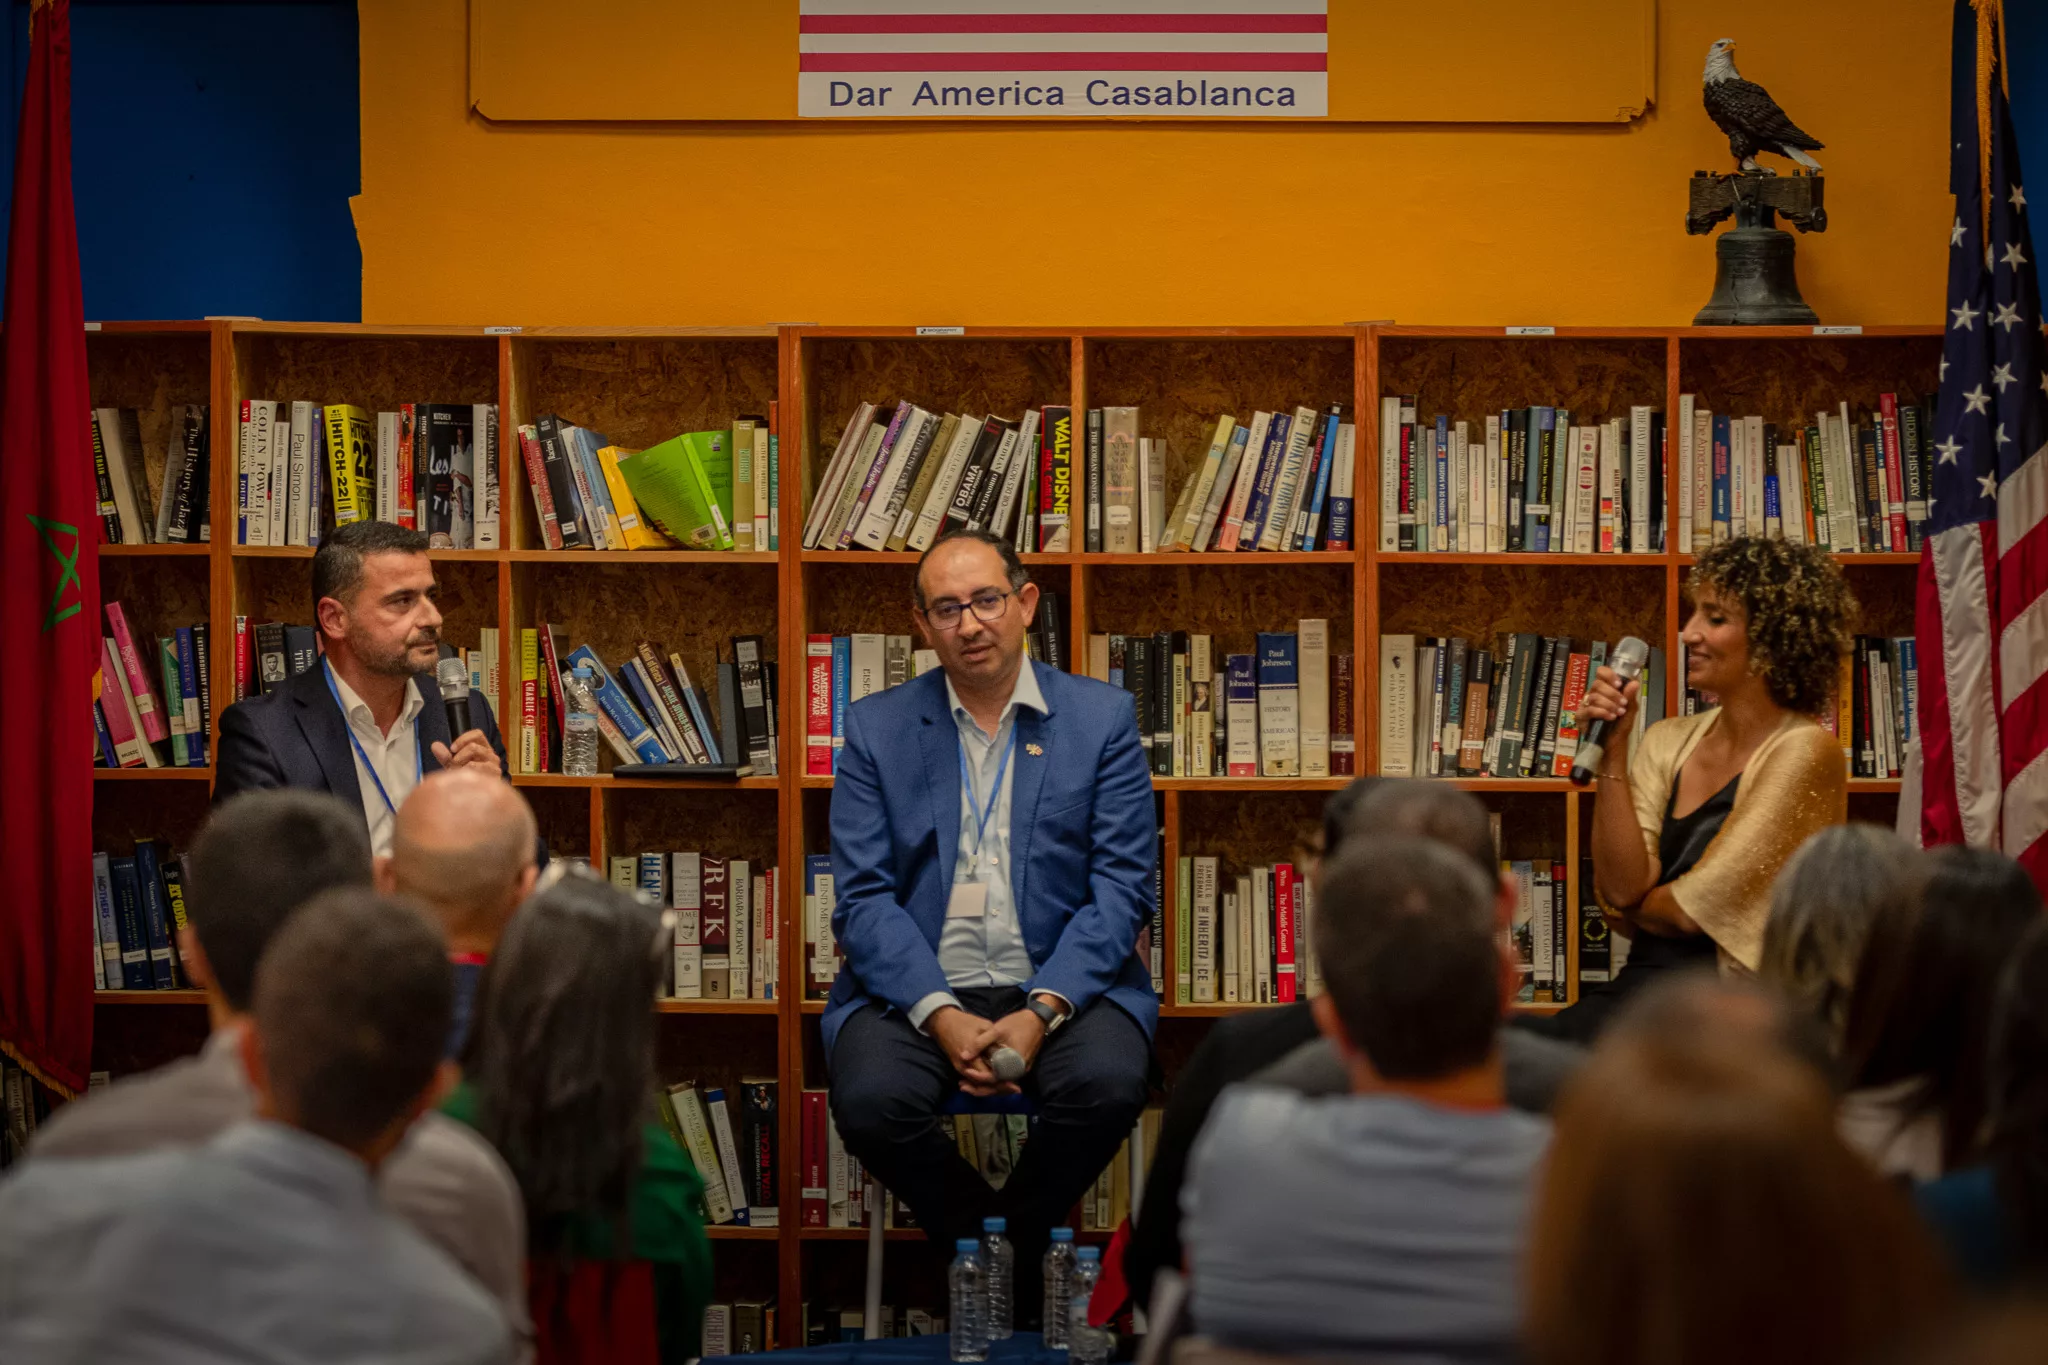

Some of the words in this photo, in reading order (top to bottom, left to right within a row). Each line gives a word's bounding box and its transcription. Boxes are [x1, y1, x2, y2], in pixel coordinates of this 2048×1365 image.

[829, 80, 892, 107] Dar
[912, 80, 1065, 107] America
[1086, 79, 1296, 107] Casablanca
[242, 406, 249, 419] MY
[433, 412, 451, 420] KITCHEN
[1636, 410, 1648, 426] THE
[188, 426, 200, 446] The
[258, 406, 268, 454] COLIN
[487, 414, 496, 465] KATHARINE
[1003, 432, 1014, 449] BOB
[1054, 416, 1070, 464] WALT
[1636, 427, 1648, 442] DAY
[1697, 420, 1708, 437] The
[1906, 411, 1917, 452] HIDDEN
[293, 433, 305, 459] Paul
[354, 440, 374, 479] 22
[904, 420, 931, 474] KATHARINE
[994, 446, 1008, 471] DYLAN
[1090, 445, 1098, 473] KOREAN
[1263, 439, 1278, 471] American
[1284, 430, 1308, 481] LOOKING
[1636, 443, 1648, 462] JOHN
[95, 455, 105, 475] TRAIN
[180, 446, 199, 491] History
[332, 423, 348, 497] HITCH-22
[1263, 440, 1283, 489] Interpretations
[1636, 463, 1648, 482] DIED
[1697, 440, 1708, 482] American
[291, 463, 304, 501] Simon
[771, 473, 778, 483] OF
[866, 466, 882, 488] Joplin
[955, 464, 981, 508] OBAMA
[1256, 470, 1269, 495] History
[1613, 469, 1621, 487] MARTIN
[1908, 455, 1920, 497] HISTORY
[180, 493, 191, 506] of
[1053, 467, 1071, 528] DISNE
[1271, 481, 1296, 532] FORWARD
[1409, 501, 1416, 510] OF
[1613, 489, 1621, 505] LUTHER
[1697, 484, 1708, 511] South
[1613, 507, 1621, 518] KING
[180, 634, 189, 661] BEYOND
[197, 637, 207, 685] EXTRAORDINARY
[294, 650, 305, 672] THE
[1268, 649, 1285, 657] Paul
[649, 665, 664, 682] Grace
[812, 666, 820, 681] WAY
[1262, 658, 1292, 667] Johnson
[812, 681, 820, 695] OF
[1229, 680, 1256, 688] Johnson
[1389, 673, 1398, 692] with
[1449, 663, 1462, 717] AMERICAN
[1538, 654, 1552, 699] AUTOBIOGRAPHY
[1567, 658, 1581, 707] AMERICA
[1578, 659, 1588, 694] COMING
[525, 682, 536, 712] CHARLIE
[662, 684, 678, 704] JACKIE
[812, 696, 820, 715] WAR
[820, 671, 828, 716] AMERICAN
[1398, 673, 1406, 739] RENDEZVOUS
[1389, 695, 1397, 739] DESTINY
[121, 749, 139, 759] MUSIC
[97, 875, 110, 918] MOTHERS
[148, 881, 158, 910] Women's
[168, 883, 183, 899] AT
[704, 865, 725, 938] RFK
[735, 878, 744, 917] BARBARA
[820, 878, 828, 905] LEND
[1279, 893, 1287, 906] The
[172, 900, 187, 930] ODDS
[820, 908, 828, 923] ME
[1279, 906, 1288, 927] Middle
[1542, 899, 1551, 938] RESTLESS
[735, 920, 744, 955] JORDAN
[820, 924, 828, 951] YOUR
[1197, 916, 1209, 981] INHERITACE
[1280, 928, 1289, 953] Ground
[1543, 938, 1552, 965] GIANT
[760, 1124, 770, 1167] RECALL
[760, 1170, 770, 1205] TOTAL
[705, 1307, 725, 1344] ARTHUR
